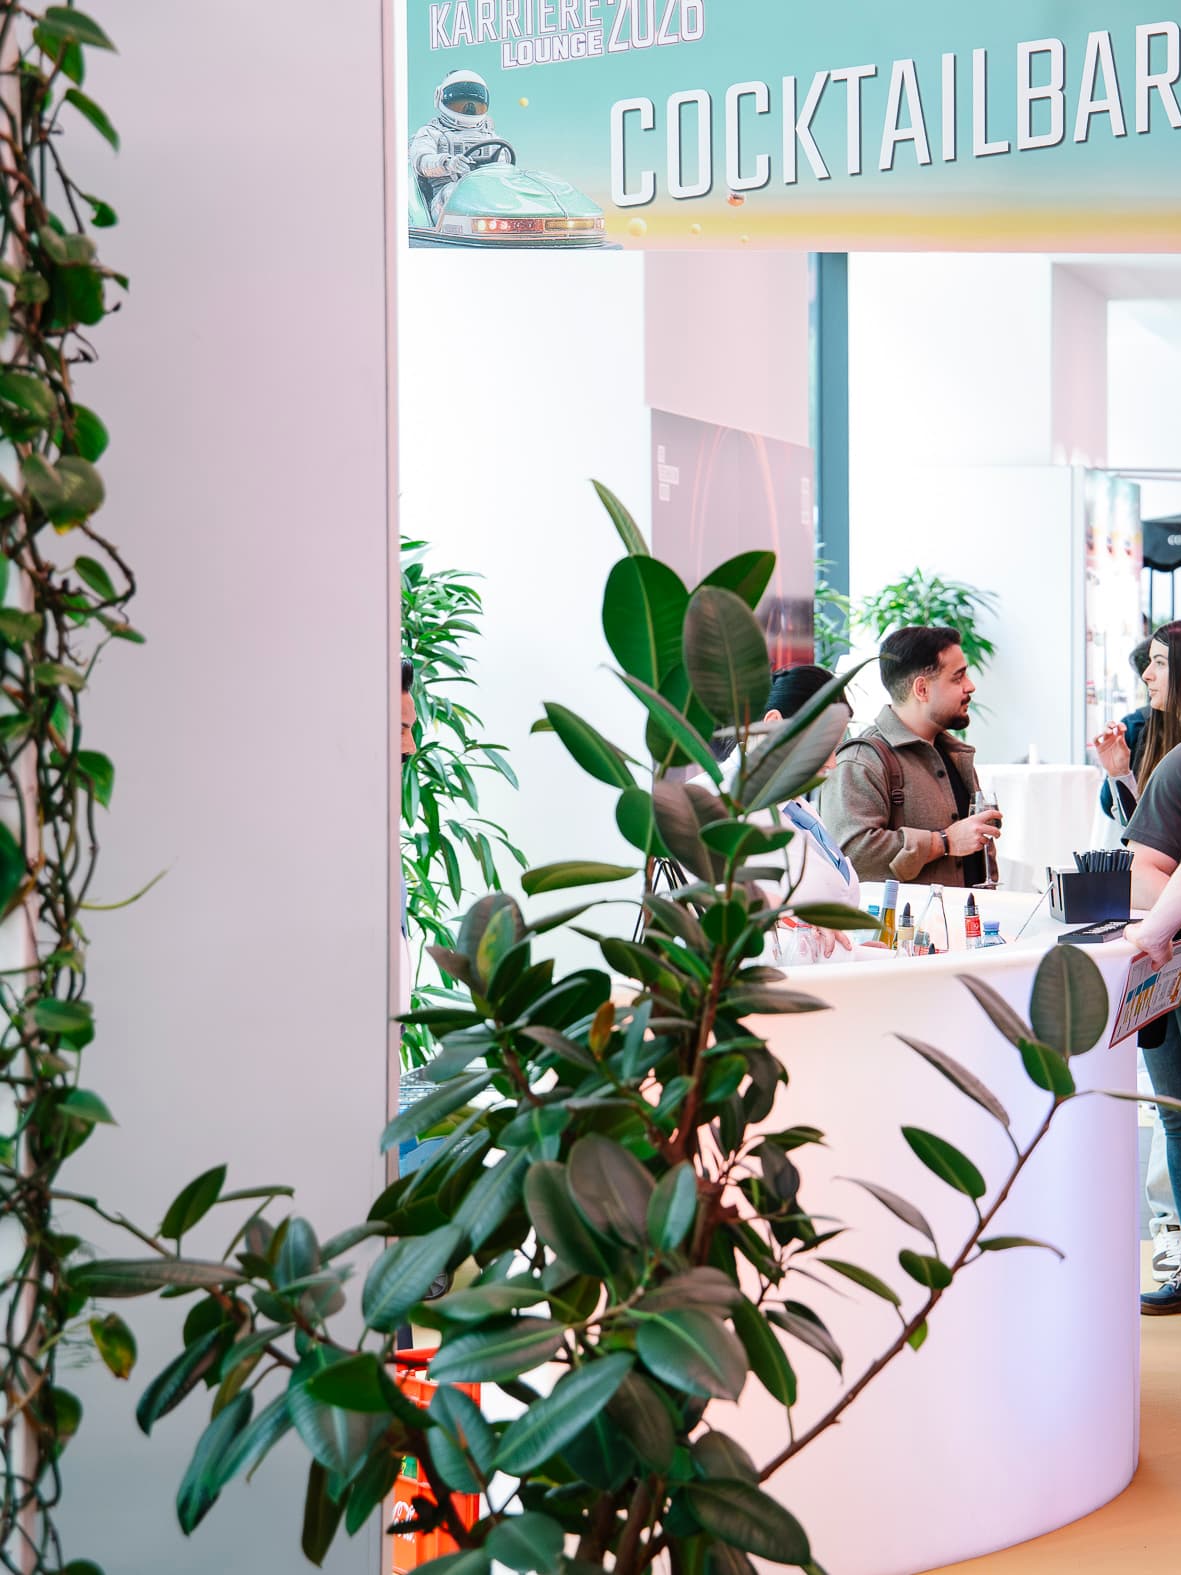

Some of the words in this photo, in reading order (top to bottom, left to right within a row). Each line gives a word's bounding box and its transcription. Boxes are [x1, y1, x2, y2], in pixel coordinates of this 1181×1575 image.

[429, 0, 603, 49] KARRIERE
[606, 0, 705, 53] 2026
[501, 29, 603, 69] LOUNGE
